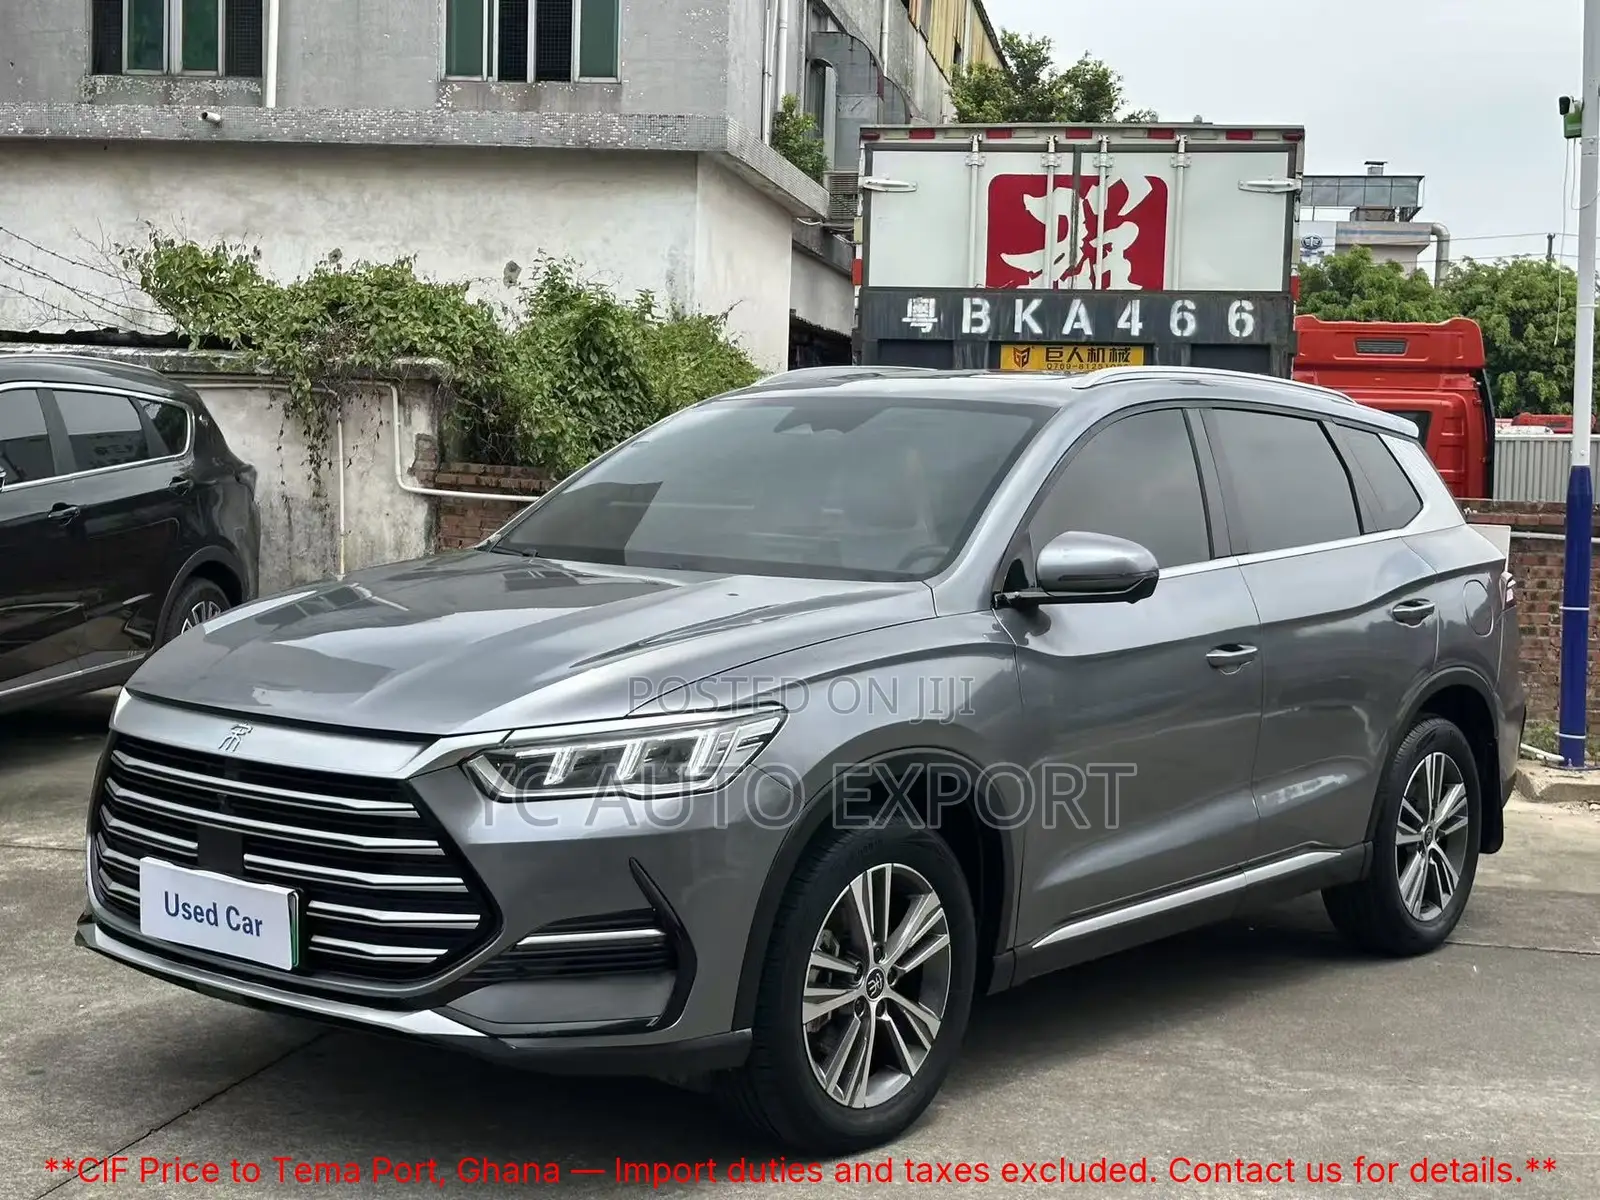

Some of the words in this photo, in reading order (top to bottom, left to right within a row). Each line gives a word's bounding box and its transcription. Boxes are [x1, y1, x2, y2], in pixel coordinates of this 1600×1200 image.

[1045, 346, 1131, 363] 巨人机械
[163, 891, 219, 927] Used
[225, 908, 263, 938] Car
